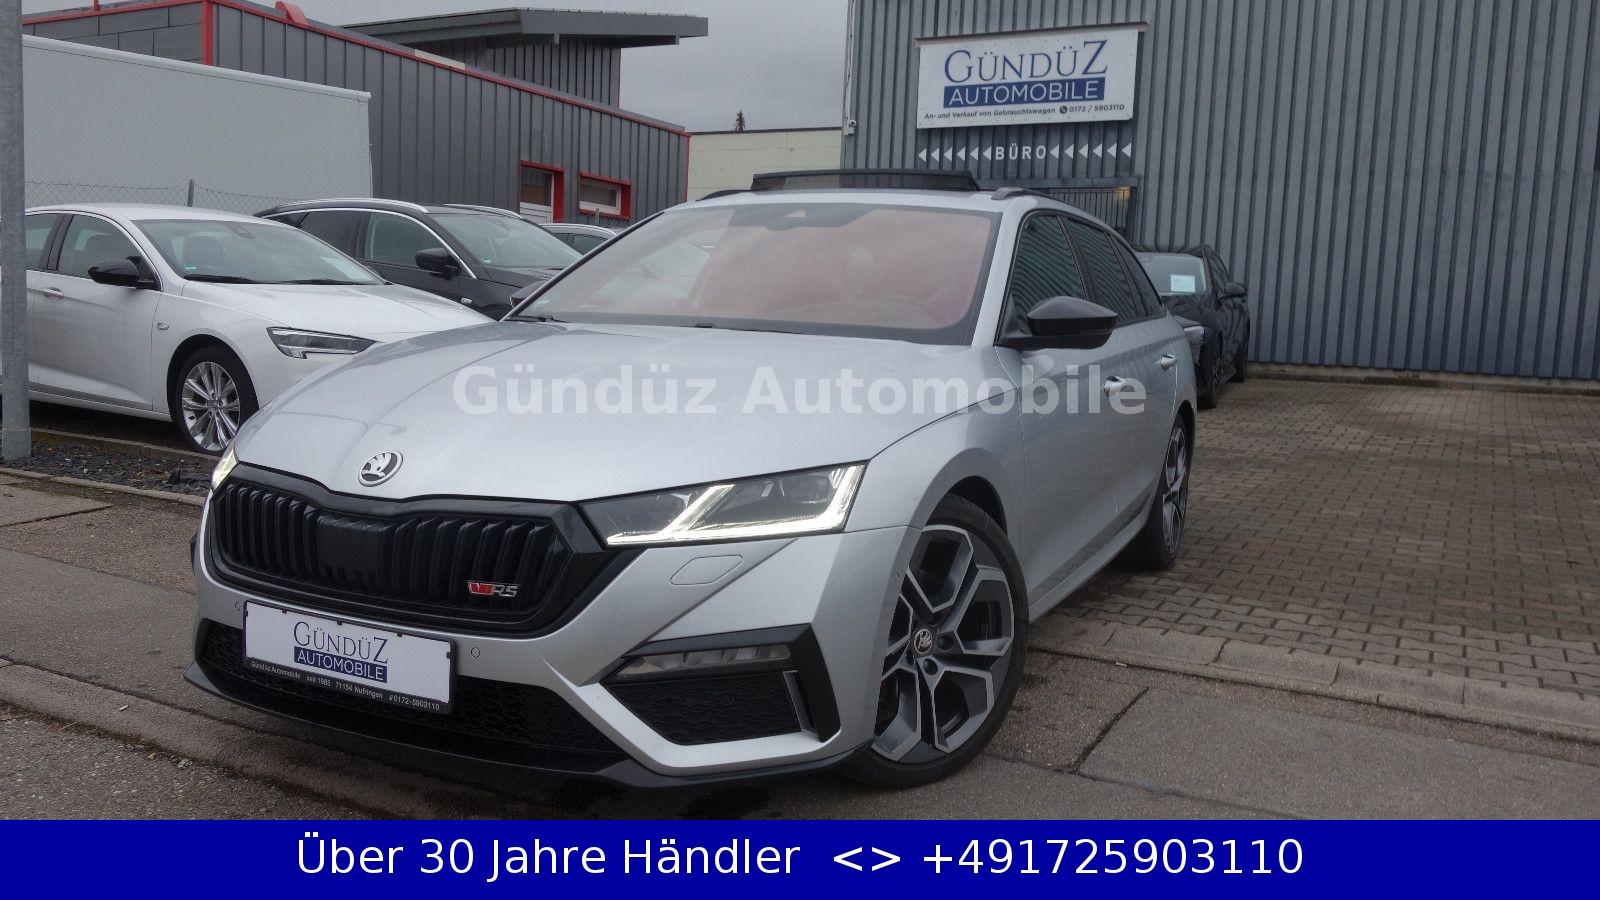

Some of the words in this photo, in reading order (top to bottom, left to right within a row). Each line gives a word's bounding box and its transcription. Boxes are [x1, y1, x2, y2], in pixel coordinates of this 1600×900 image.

[944, 39, 1108, 83] GÜNDÜZ
[948, 79, 1099, 106] AUTOMOBILE
[993, 107, 1056, 117] Gebrauchtswagen
[1094, 104, 1125, 112] 5903110
[995, 142, 1047, 160] BÜRO
[293, 621, 389, 664] GÜNDÜZ
[297, 649, 385, 682] AUTOMOBILE
[335, 682, 353, 692] 71154
